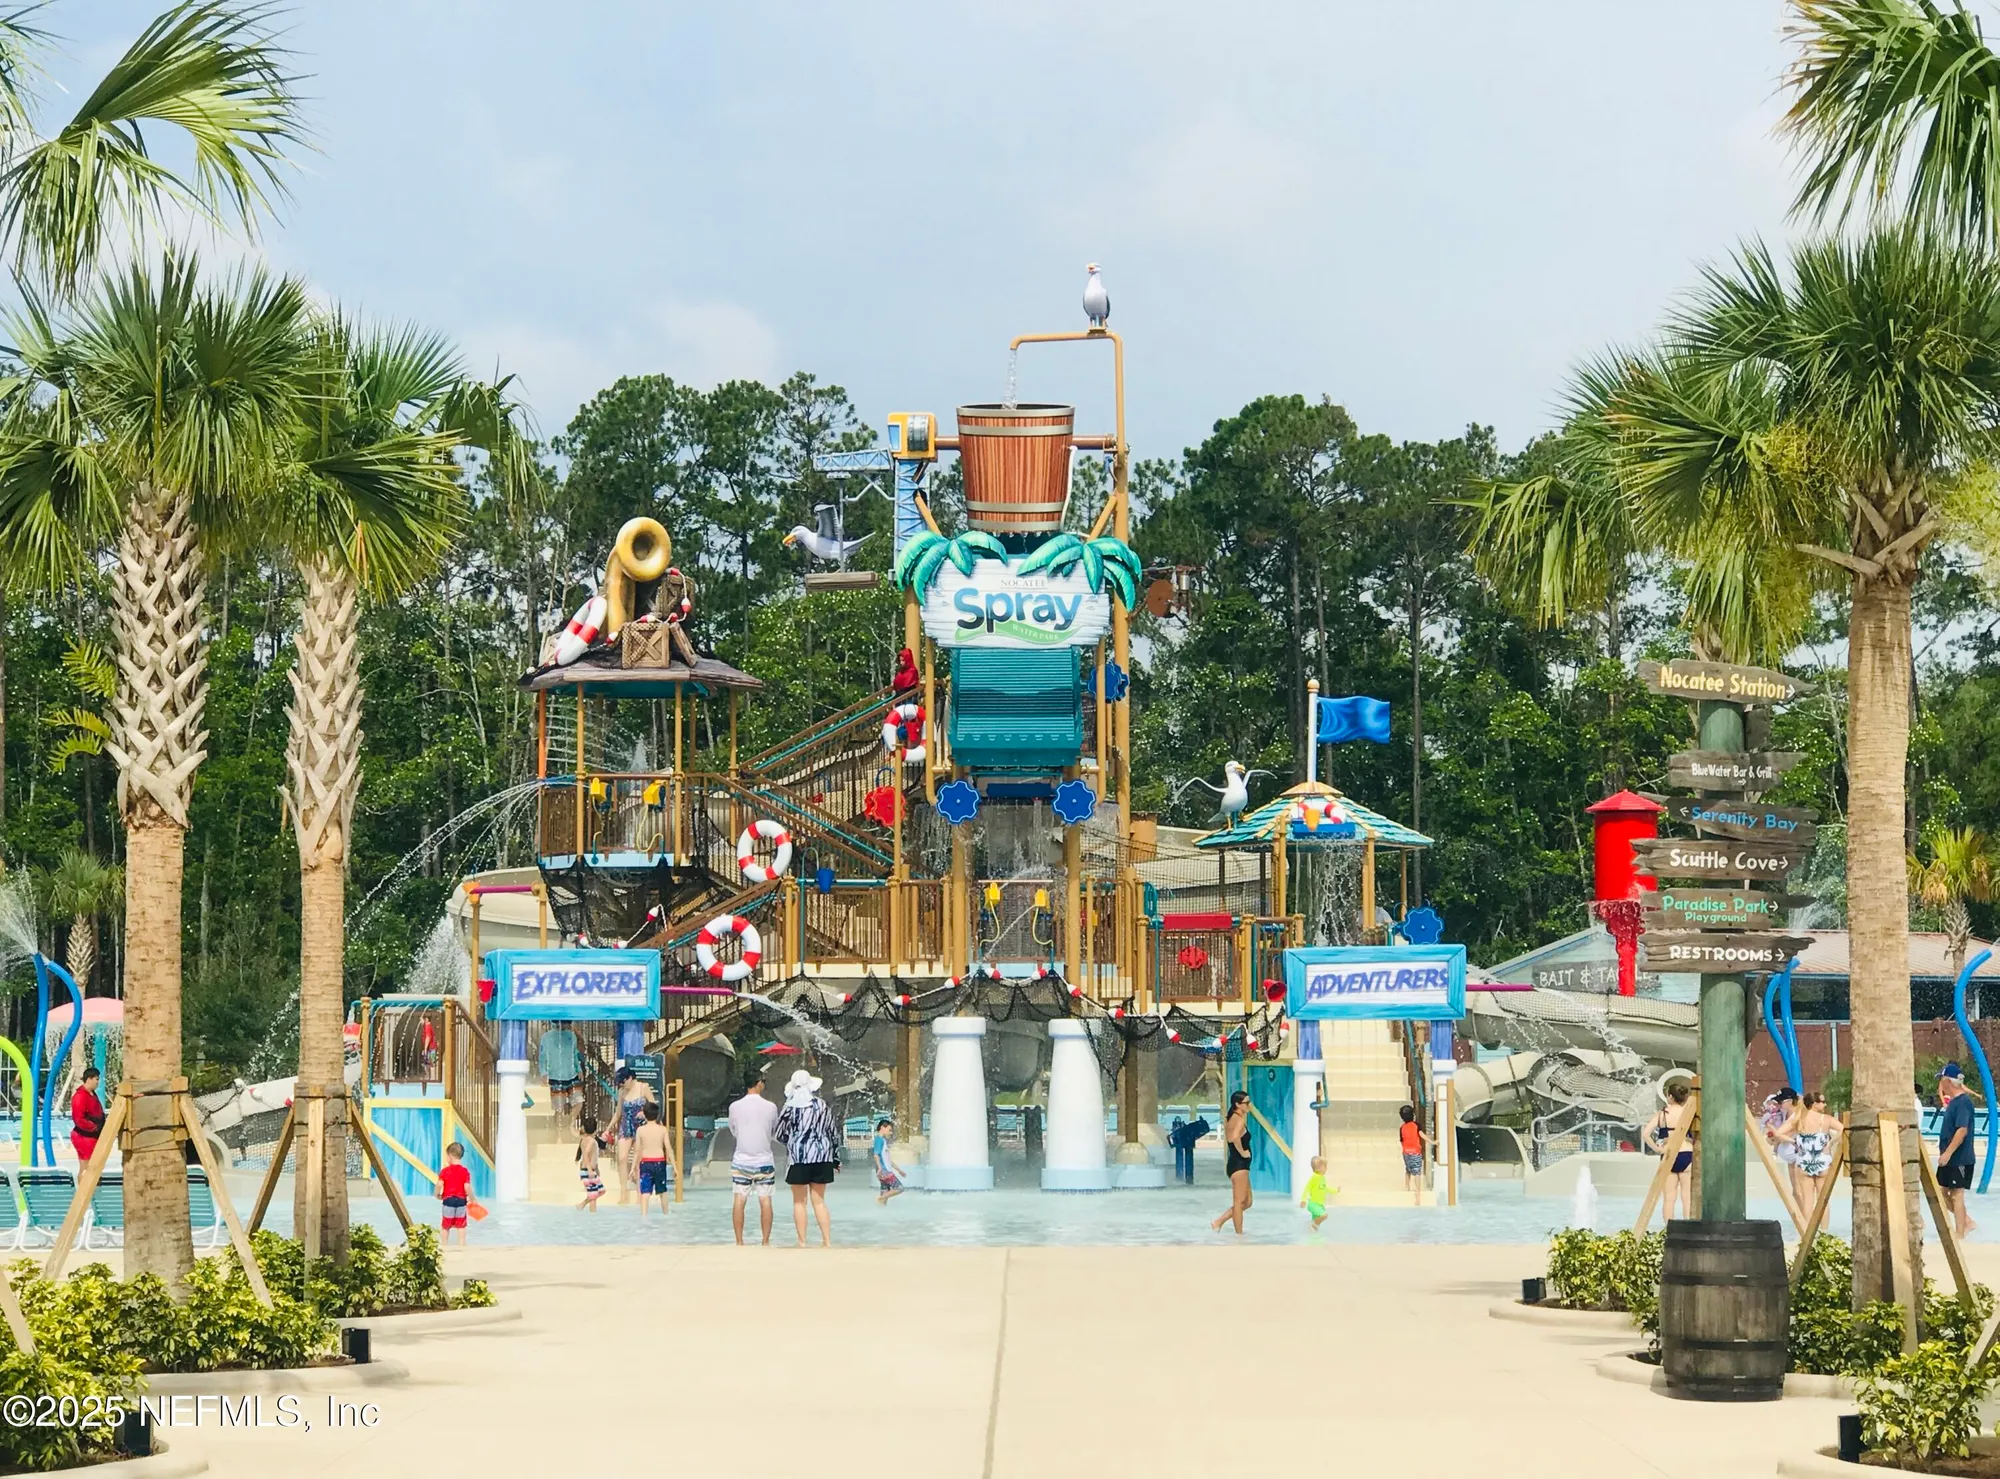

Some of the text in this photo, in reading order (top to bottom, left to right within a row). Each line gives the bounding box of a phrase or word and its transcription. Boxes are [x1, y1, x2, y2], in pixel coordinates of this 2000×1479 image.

[1000, 579, 1046, 588] NOCATEE
[954, 587, 1082, 633] Spray
[1660, 666, 1786, 699] Nocatee Station
[1691, 763, 1772, 779] BlueWater Bar & Grill
[1691, 806, 1798, 833] Serenity Bay
[1669, 848, 1778, 871] Scuttle Cove
[1662, 895, 1769, 914] Paradise Park
[1685, 912, 1747, 924] Playground
[1669, 945, 1773, 962] RESTROOMS
[516, 971, 643, 1001] EXPLORERS
[1307, 968, 1449, 1000] ADVENTURERS
[1539, 965, 1653, 987] BAIT & TALE
